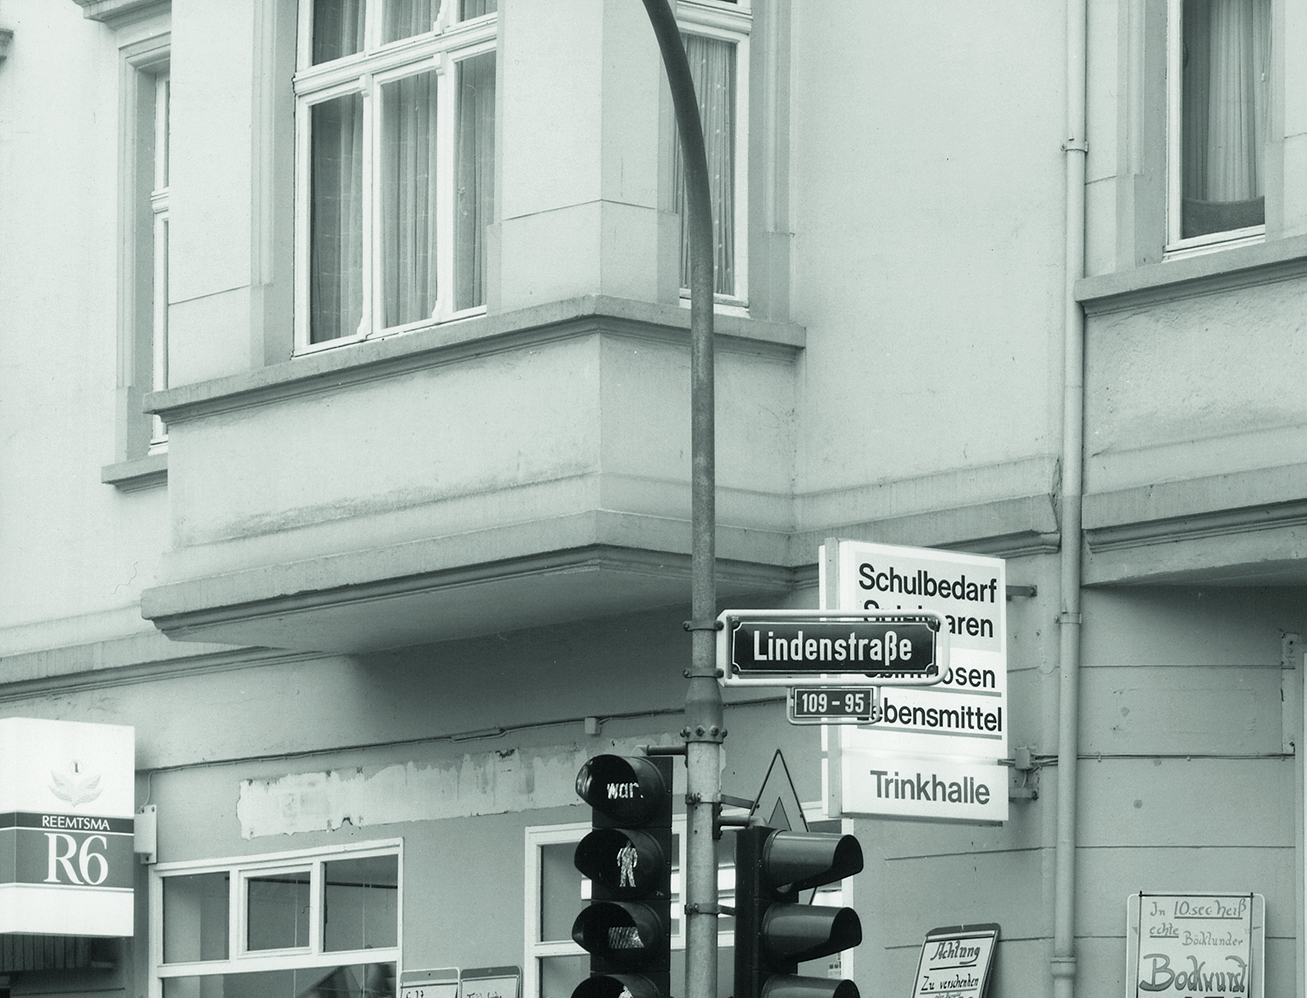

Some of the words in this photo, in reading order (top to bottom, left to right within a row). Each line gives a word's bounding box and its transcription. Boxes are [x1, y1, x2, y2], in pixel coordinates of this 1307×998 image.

[859, 563, 997, 603] Schulbedarf
[753, 631, 912, 666] Lindenstraße
[802, 693, 827, 712] 109
[845, 693, 865, 713] 95
[857, 697, 1002, 732] ebensmittel
[870, 770, 990, 804] Trinkhalle
[42, 816, 110, 830] REEMTSMA
[44, 833, 108, 885] R6
[1214, 899, 1246, 917] heiß
[1150, 923, 1179, 935] echte
